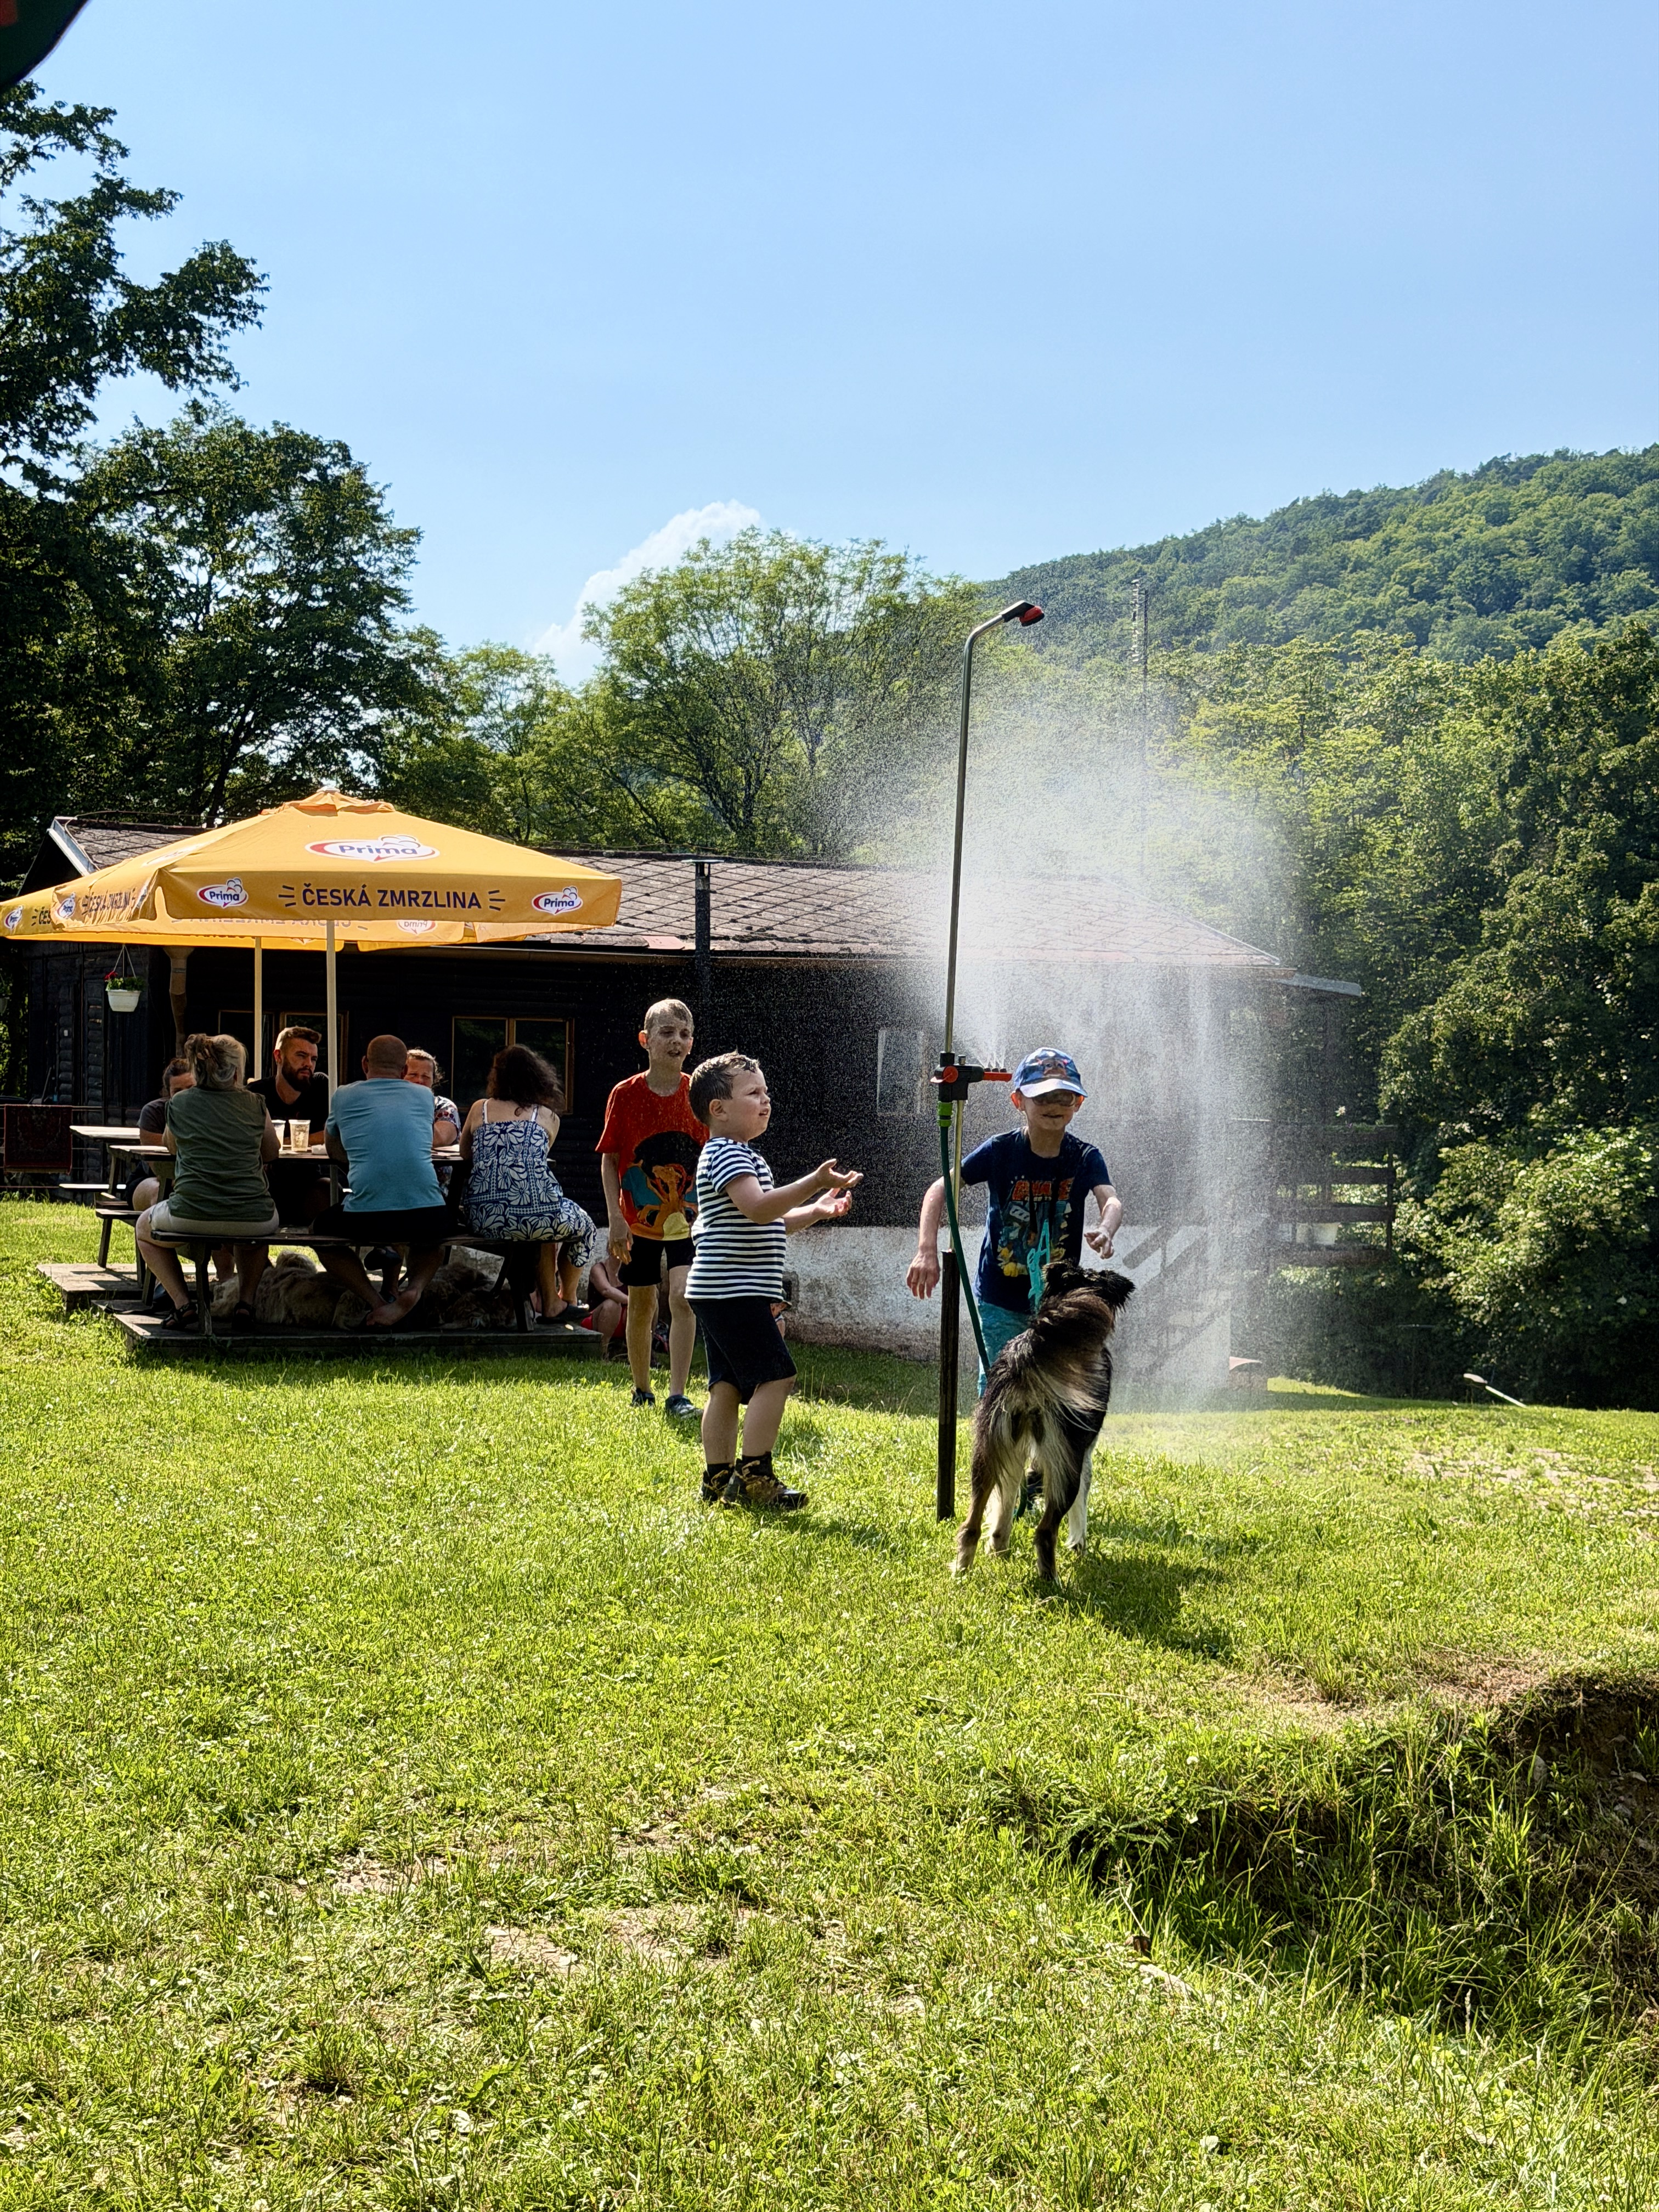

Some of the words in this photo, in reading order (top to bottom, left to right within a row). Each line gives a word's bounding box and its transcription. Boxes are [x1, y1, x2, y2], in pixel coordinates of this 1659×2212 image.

[338, 845, 418, 855] Prima
[209, 890, 240, 901] Prima
[302, 883, 372, 906] ČESKÁ
[377, 889, 482, 909] ZMRZLINA
[544, 898, 574, 907] Prima
